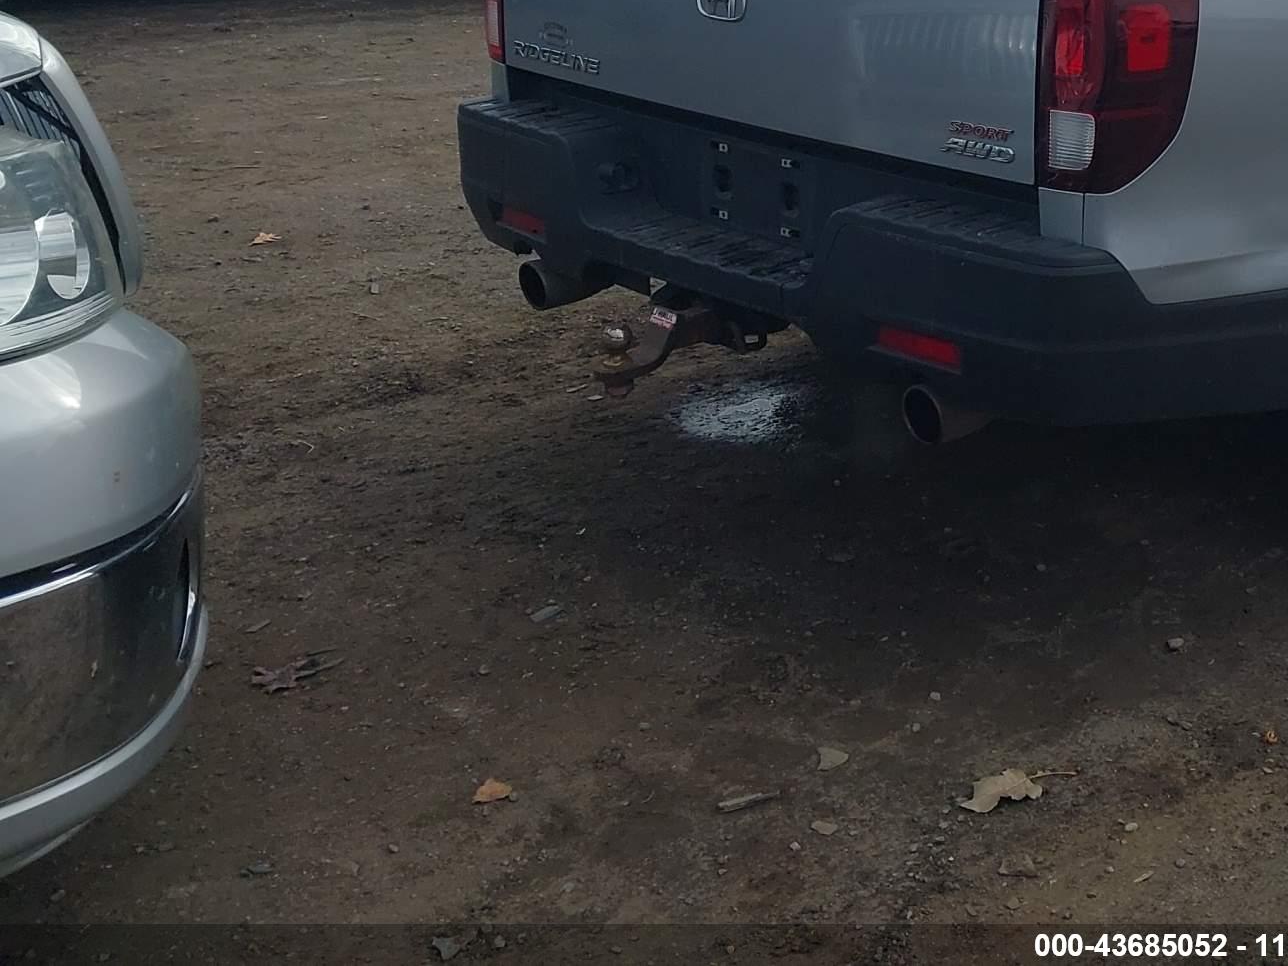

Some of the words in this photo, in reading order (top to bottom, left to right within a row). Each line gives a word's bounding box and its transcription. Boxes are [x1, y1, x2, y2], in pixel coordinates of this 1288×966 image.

[513, 40, 600, 74] RIDGELINE
[949, 120, 1014, 142] SPORT
[940, 137, 1015, 164] AWD
